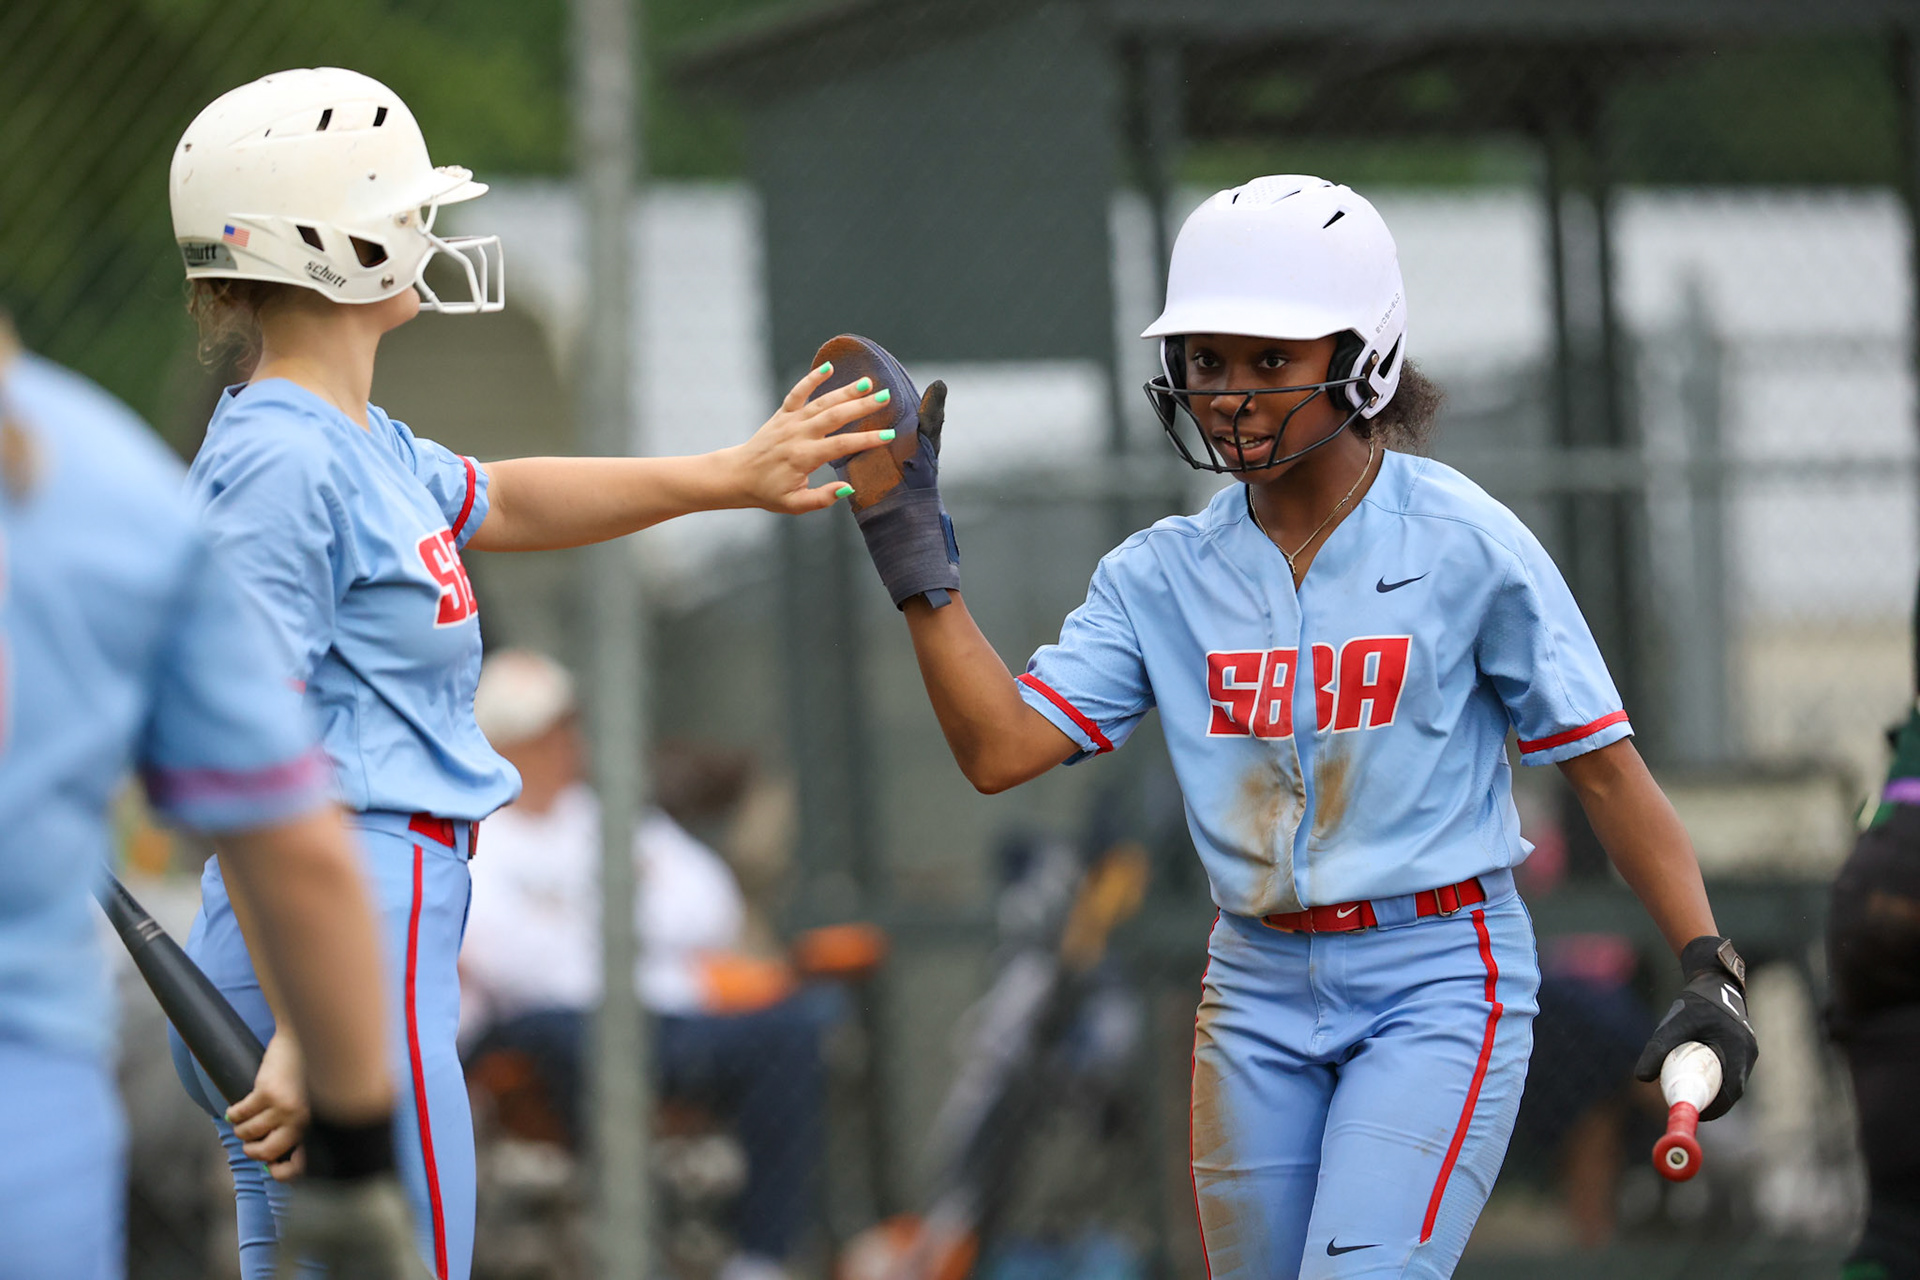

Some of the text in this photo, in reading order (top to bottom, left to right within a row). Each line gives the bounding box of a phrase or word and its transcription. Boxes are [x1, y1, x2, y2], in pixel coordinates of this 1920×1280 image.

[182, 242, 217, 260] chutt
[305, 261, 347, 288] schutt
[1375, 292, 1400, 334] EVOSHIELD
